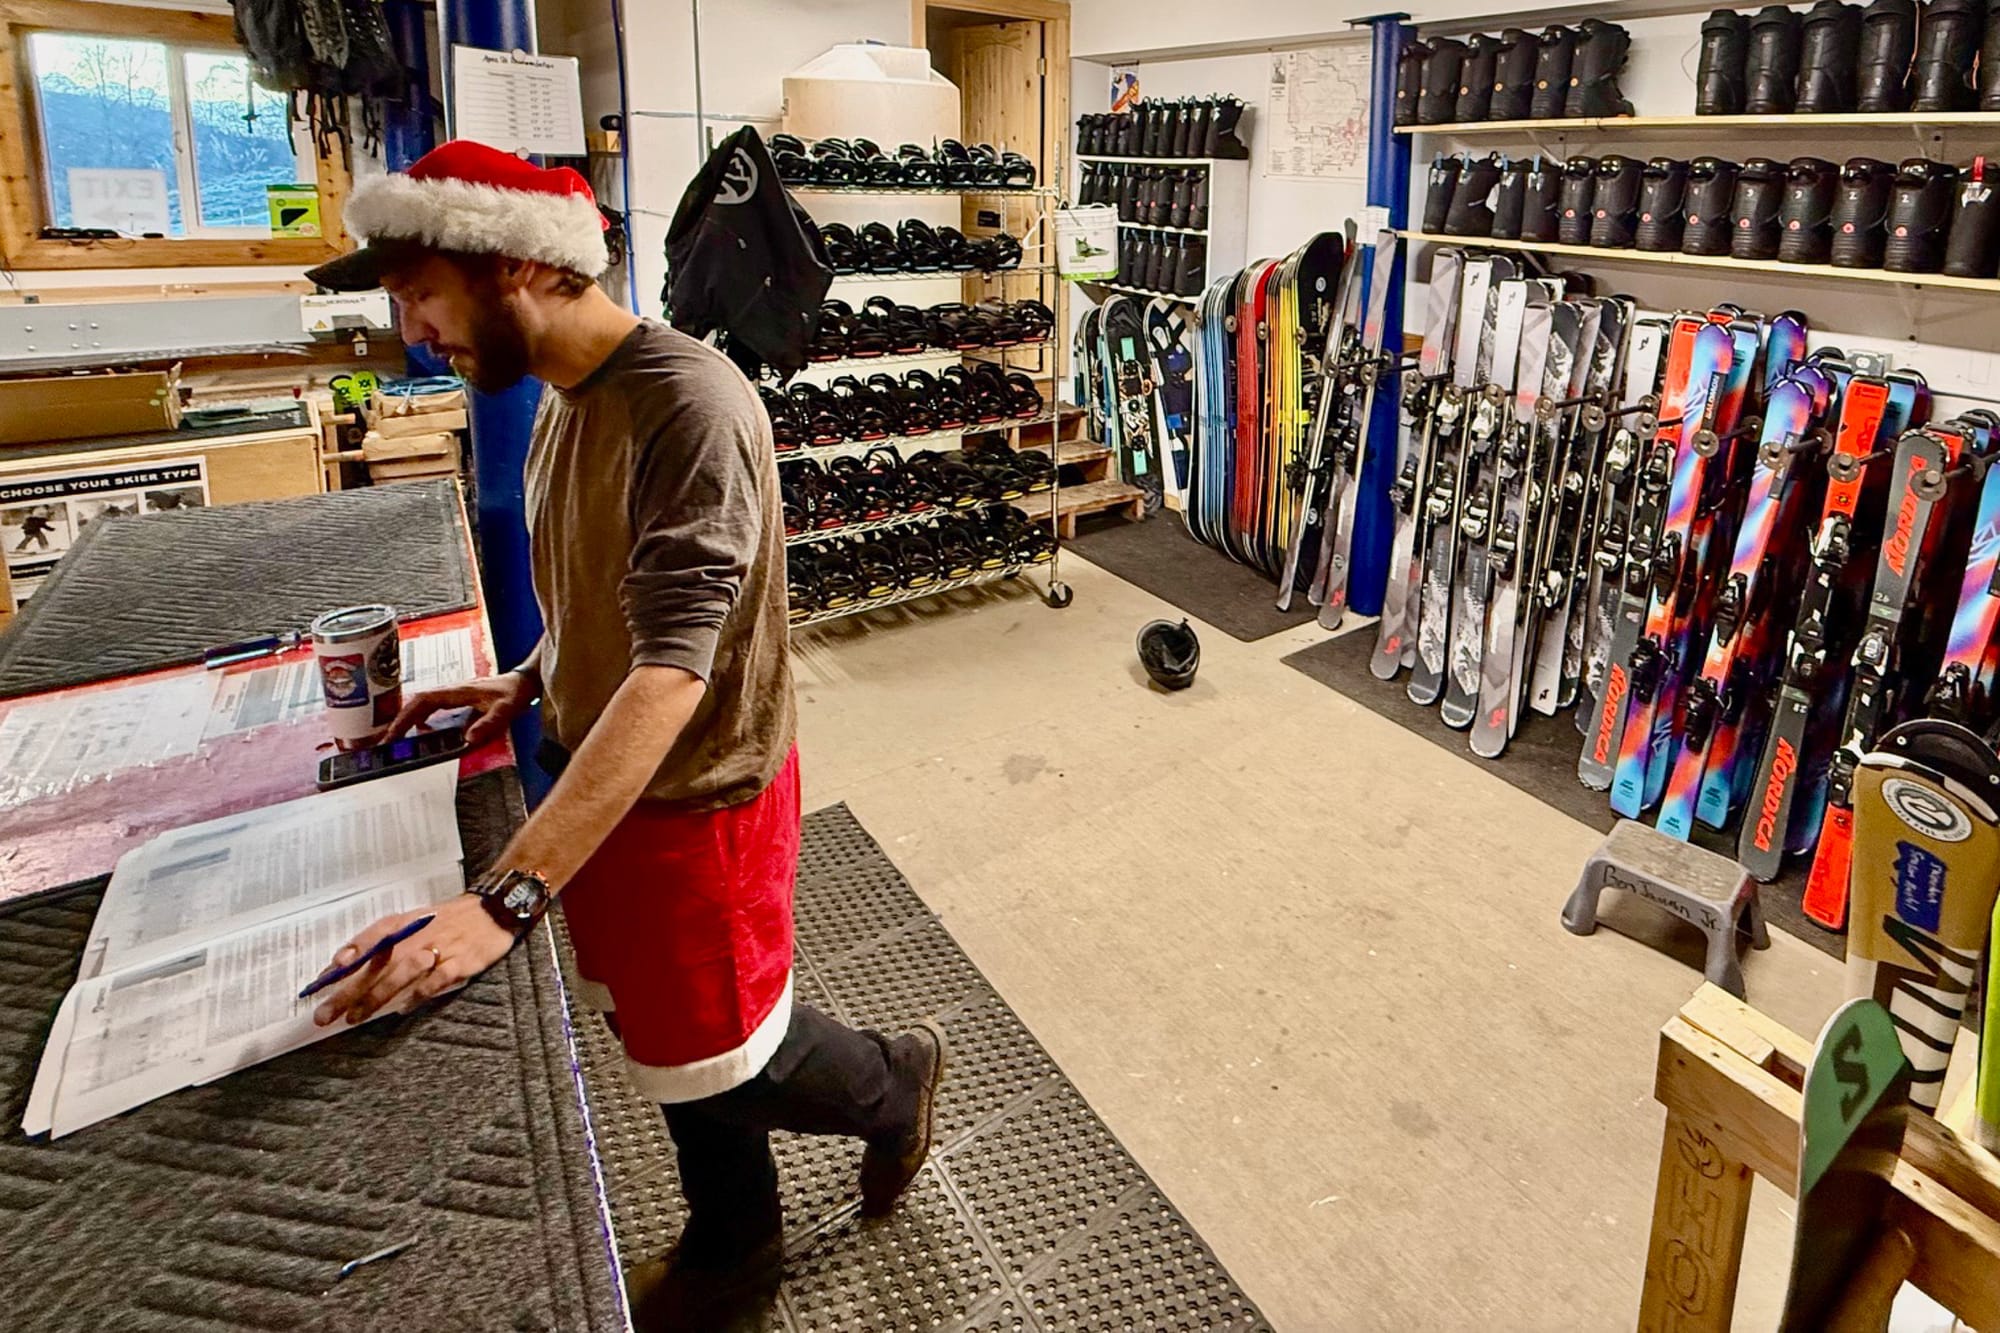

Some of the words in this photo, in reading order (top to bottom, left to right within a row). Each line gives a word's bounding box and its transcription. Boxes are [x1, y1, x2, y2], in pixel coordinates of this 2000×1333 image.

[0, 484, 65, 499] CHOOSE
[69, 479, 112, 490] YOUR
[114, 471, 159, 485] SKIER
[162, 468, 199, 479] TYPE
[1594, 663, 1626, 765] NORDICA
[1754, 736, 1797, 852] NORDICA
